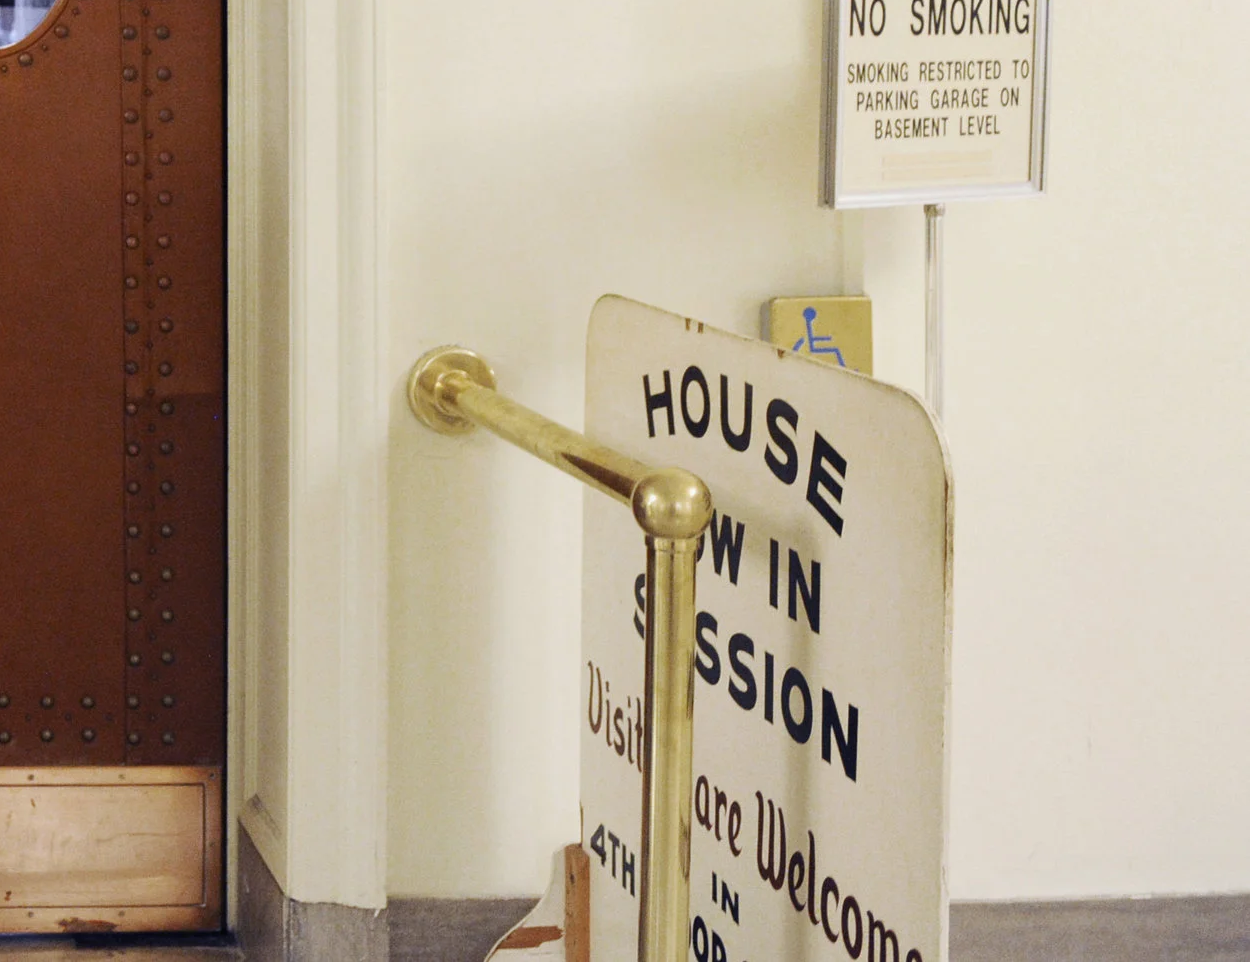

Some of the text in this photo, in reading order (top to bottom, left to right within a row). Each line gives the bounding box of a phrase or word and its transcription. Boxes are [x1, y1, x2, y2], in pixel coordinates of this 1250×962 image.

[847, 59, 1030, 84] SMOKING RESTRICTED TO
[856, 87, 1020, 112] PARKING GARAGE ON
[874, 115, 1000, 140] BASEMENT LEVEL
[642, 365, 848, 537] HOUSE
[769, 538, 821, 635] IN
[633, 573, 859, 783] SSSION
[587, 660, 644, 773] Visit
[695, 774, 742, 857] are
[755, 790, 923, 962] Welcom
[590, 823, 636, 897] 4TH
[711, 871, 740, 926] IN
